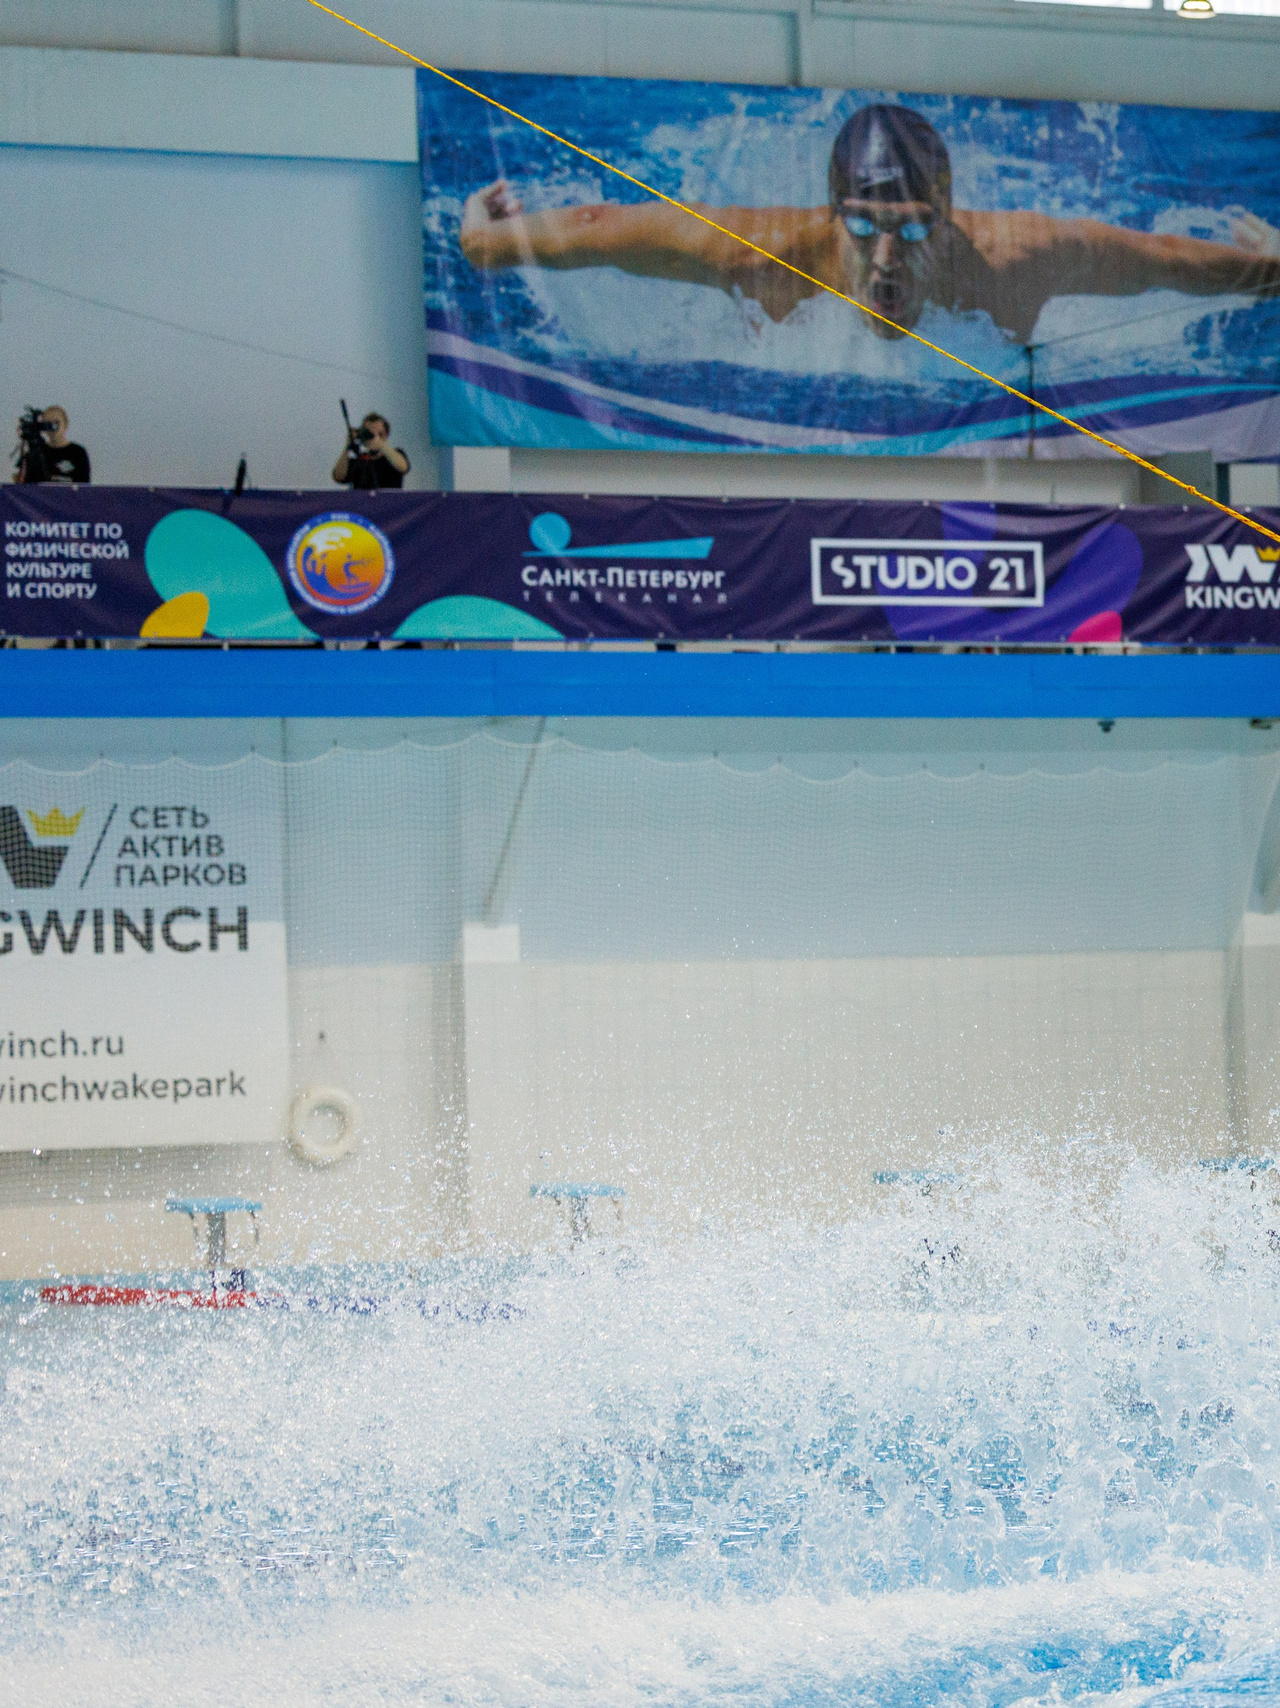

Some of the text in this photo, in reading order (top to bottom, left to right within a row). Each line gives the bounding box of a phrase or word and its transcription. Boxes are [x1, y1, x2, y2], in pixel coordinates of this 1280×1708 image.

[4, 521, 123, 539] КОМИТЕТ ПО
[5, 539, 130, 559] ФИЗИЧЕСКОЙ
[6, 562, 93, 579] КУЛЬТУРЕ
[831, 555, 1026, 591] STUDIO 21
[7, 582, 98, 599] И СПОРТУ
[130, 805, 209, 829] СЕТЬ
[118, 834, 225, 858] АКТИВ
[114, 863, 247, 888] ПАРКОВ
[0, 1029, 124, 1058] inch.ru
[0, 1070, 247, 1104] inchwakepark
